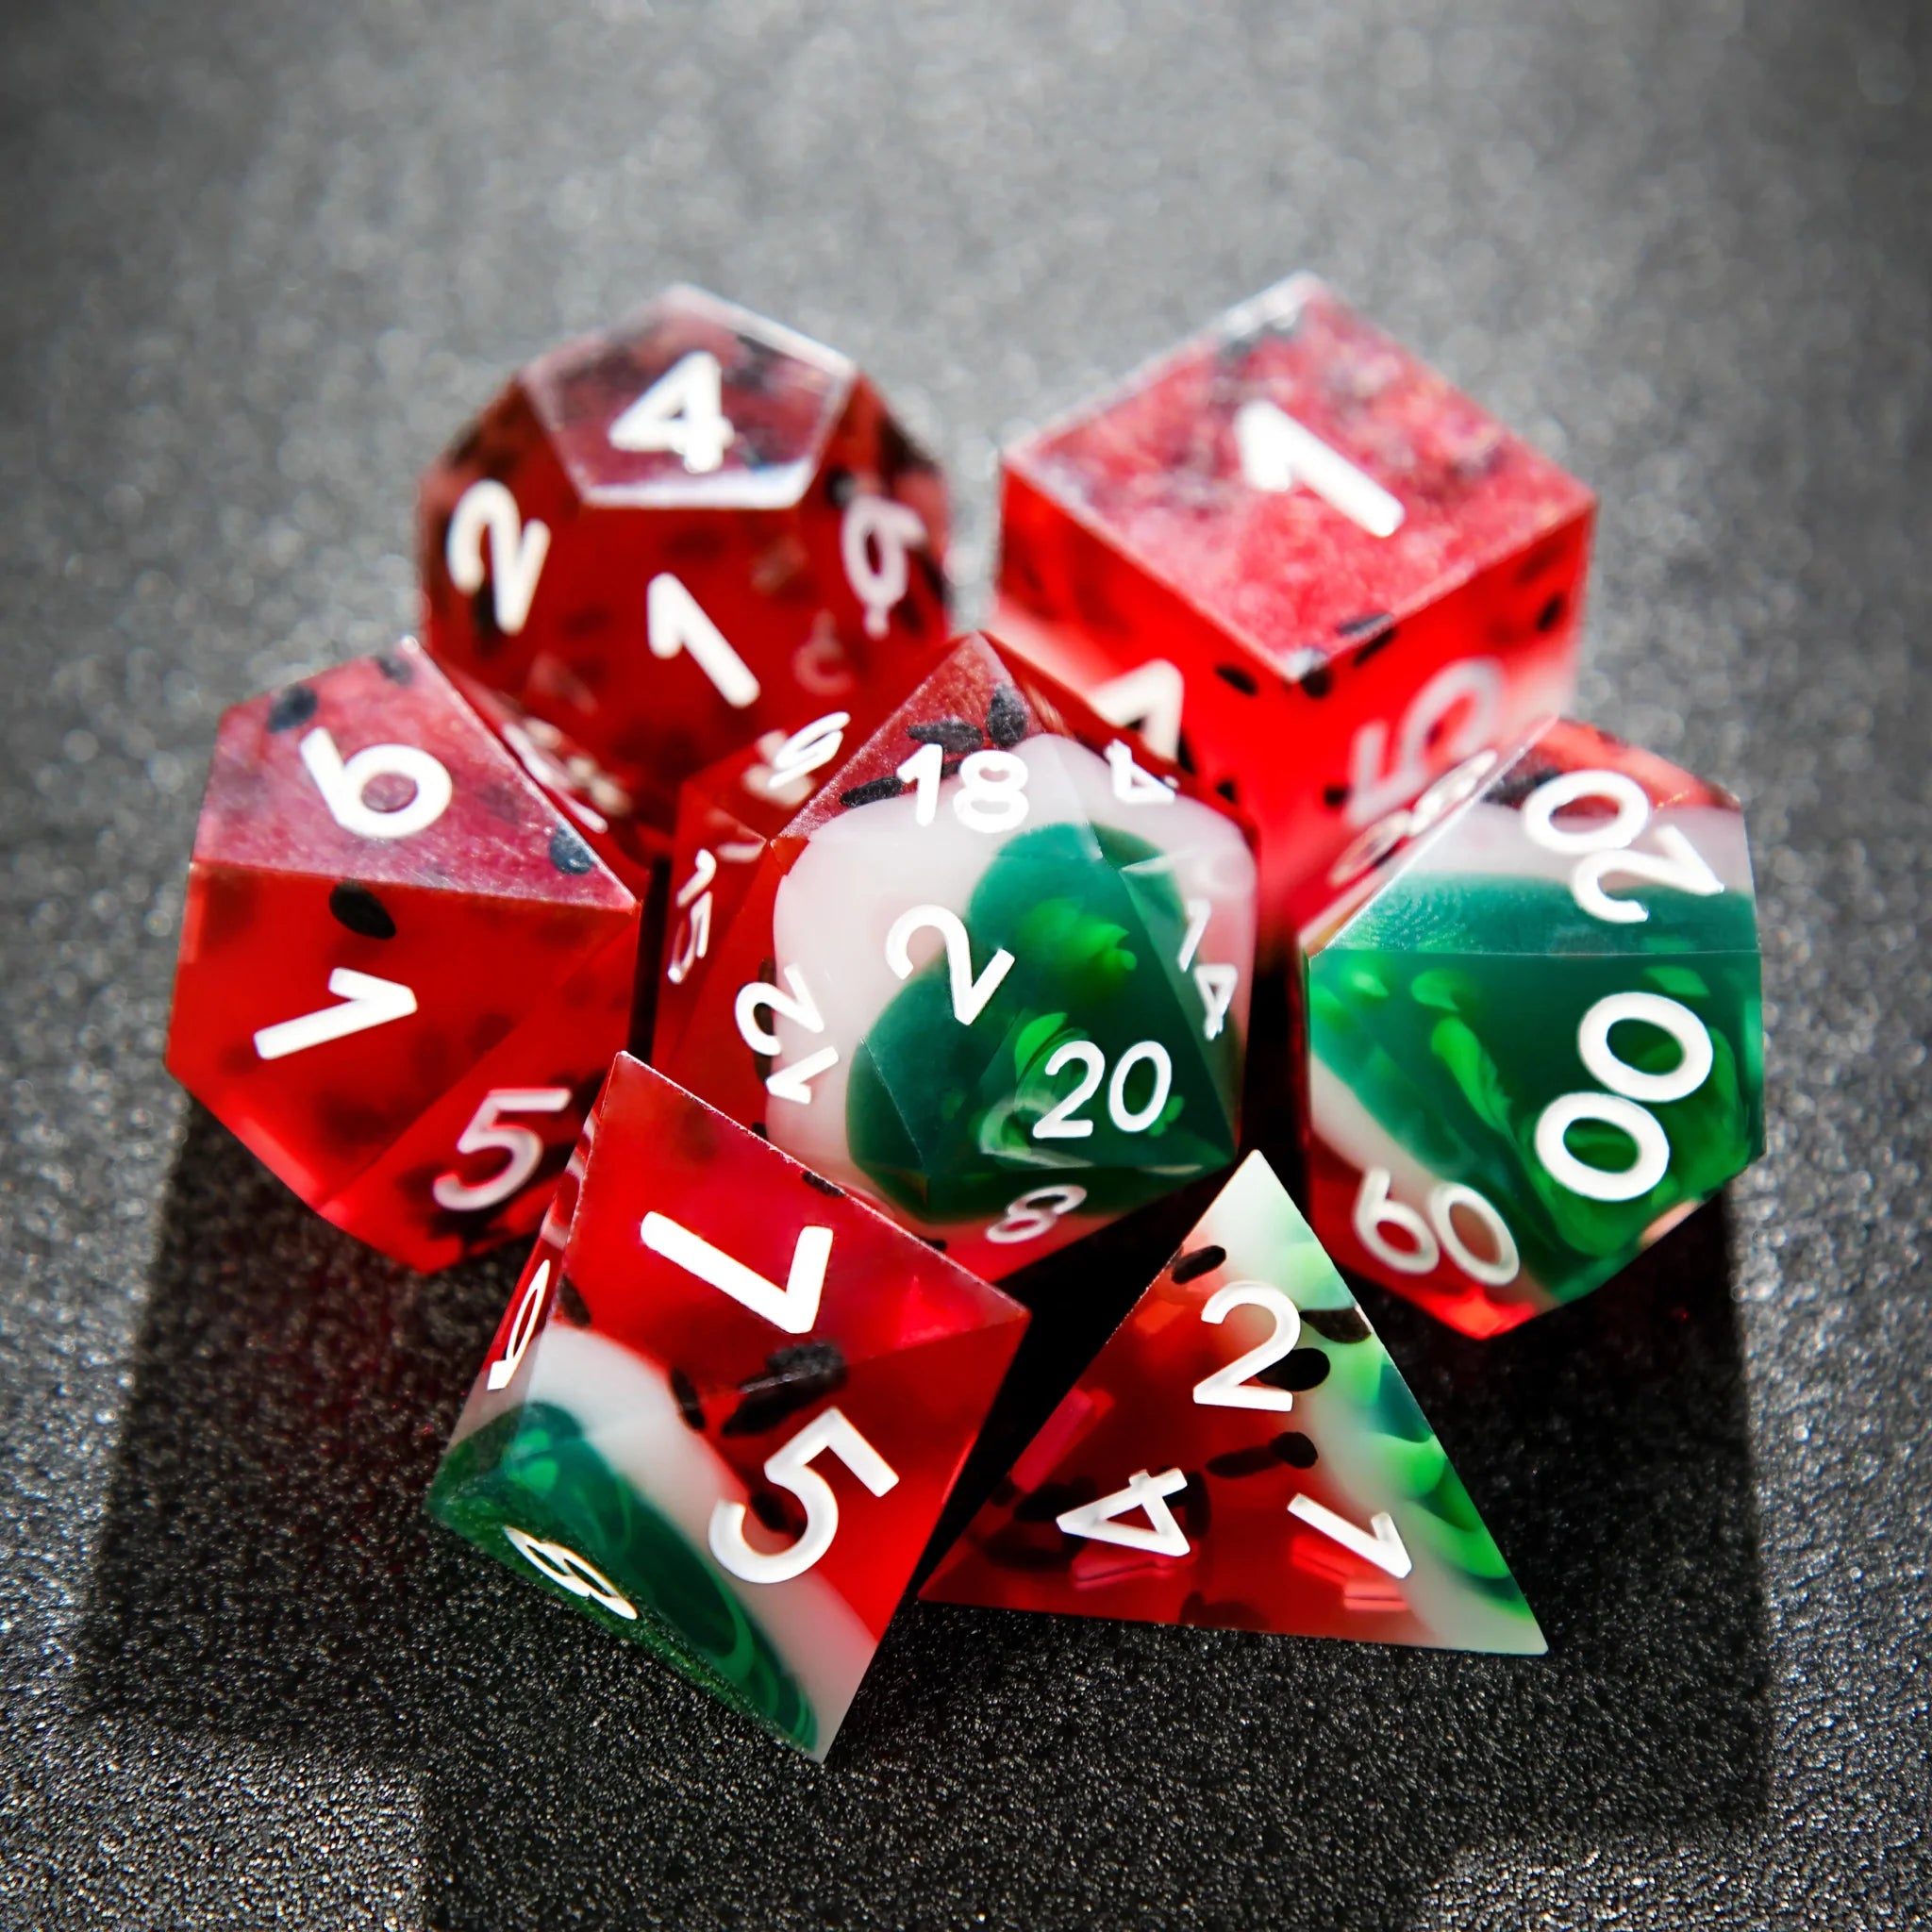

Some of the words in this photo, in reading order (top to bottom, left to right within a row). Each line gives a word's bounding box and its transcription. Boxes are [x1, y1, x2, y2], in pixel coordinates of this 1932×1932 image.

[608, 351, 734, 474] 4
[1235, 398, 1406, 538] 1
[446, 480, 551, 634] 2
[646, 573, 759, 708] 1
[897, 743, 1029, 833] 18
[254, 967, 417, 1059] 1
[885, 904, 1015, 1025] 2
[432, 1087, 572, 1211] 5
[1032, 1041, 1172, 1139] 20
[1535, 992, 1713, 1202] 00
[985, 1185, 1087, 1243] 8
[1355, 1169, 1520, 1286] 60
[1192, 1280, 1302, 1412] 2
[708, 1407, 900, 1584] 5
[1057, 1468, 1191, 1557] 4
[1286, 1493, 1412, 1579] 1
